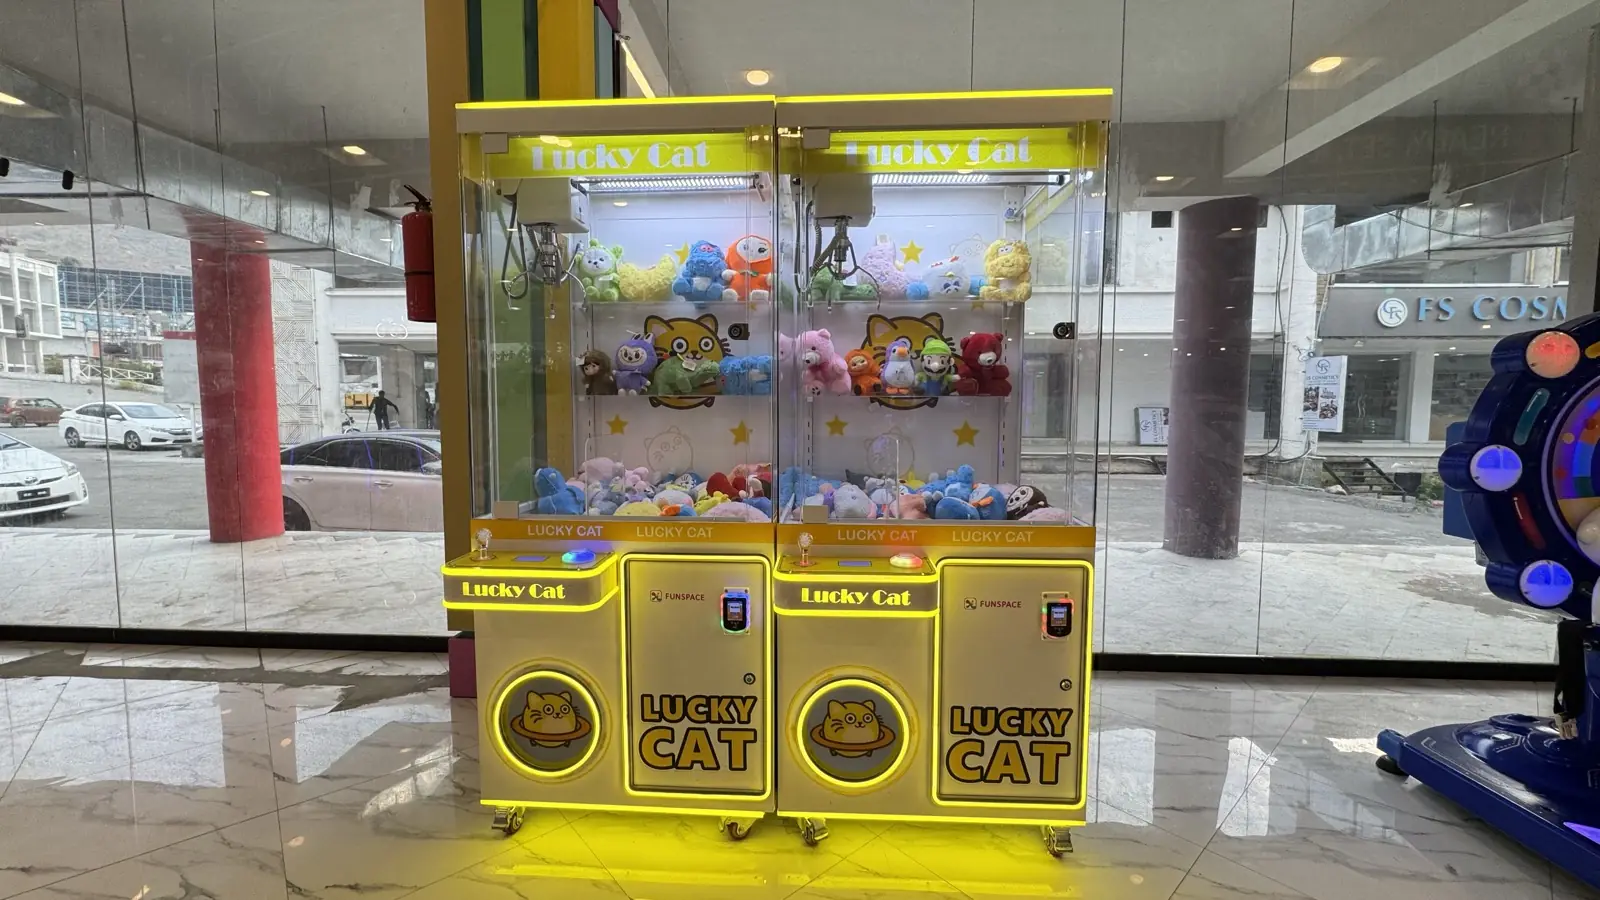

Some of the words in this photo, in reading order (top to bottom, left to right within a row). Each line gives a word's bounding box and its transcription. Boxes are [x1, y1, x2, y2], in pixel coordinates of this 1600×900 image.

[532, 143, 640, 171] Lucky
[648, 141, 711, 169] Cat
[845, 138, 960, 166] Lucky
[967, 135, 1033, 164] Cat
[1418, 296, 1456, 321] FS
[527, 525, 573, 536] LUCKY
[576, 525, 604, 537] CAT
[636, 526, 683, 538] LUCKY
[686, 526, 714, 538] CAT
[837, 529, 886, 541] LUCKY
[889, 530, 918, 541] CAT
[952, 530, 1001, 543] LUCKY
[1005, 531, 1034, 543] CAT
[462, 581, 526, 598] Lucky
[528, 583, 566, 599] Cat
[665, 592, 705, 601] FUNSPACE
[801, 587, 869, 605] Lucky
[872, 589, 911, 606] Cat
[980, 600, 1022, 609] FUNSPACE
[641, 694, 758, 724] LUCKY
[950, 706, 1073, 737] LUCKY
[639, 726, 758, 771] CAT
[946, 738, 1071, 785] CAT
